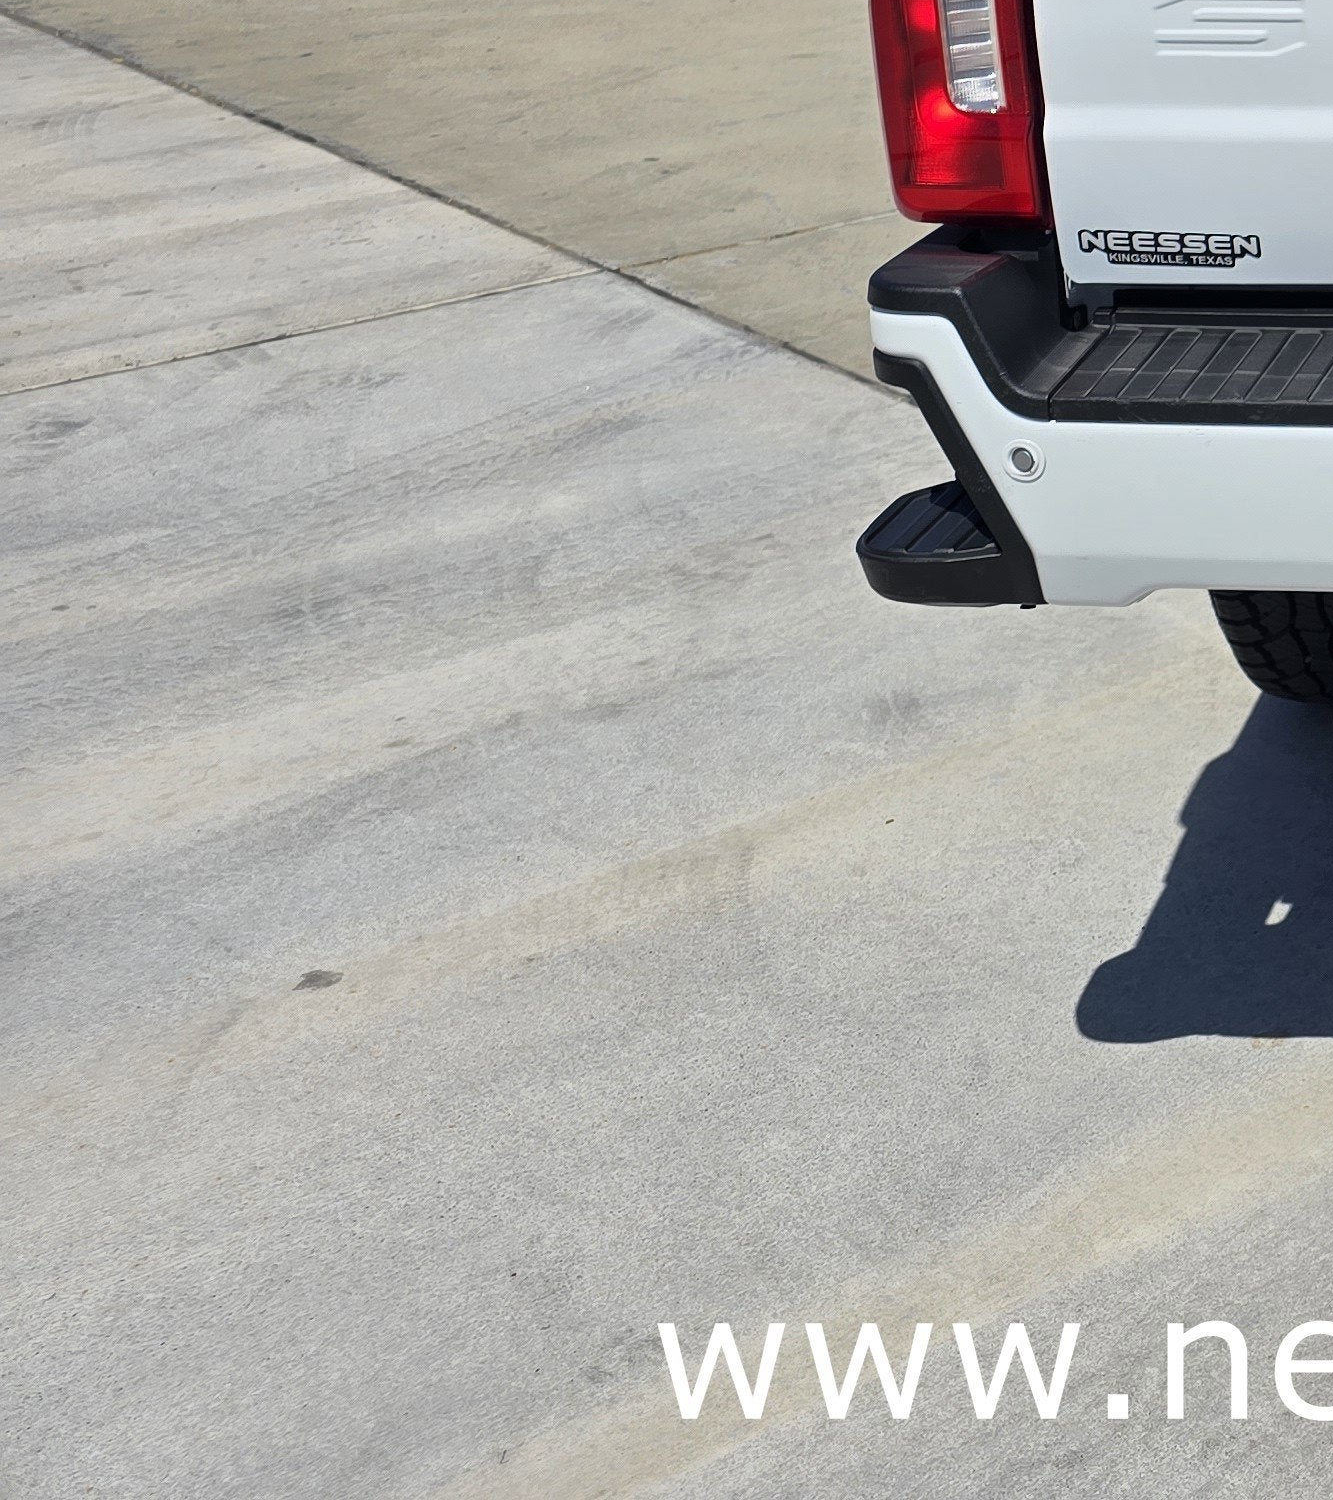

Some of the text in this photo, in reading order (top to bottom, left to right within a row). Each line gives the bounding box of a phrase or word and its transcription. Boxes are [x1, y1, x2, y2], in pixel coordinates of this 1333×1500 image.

[1079, 230, 1260, 256] NEESSEN
[1108, 252, 1234, 266] KINGSVILLE, TEXAS
